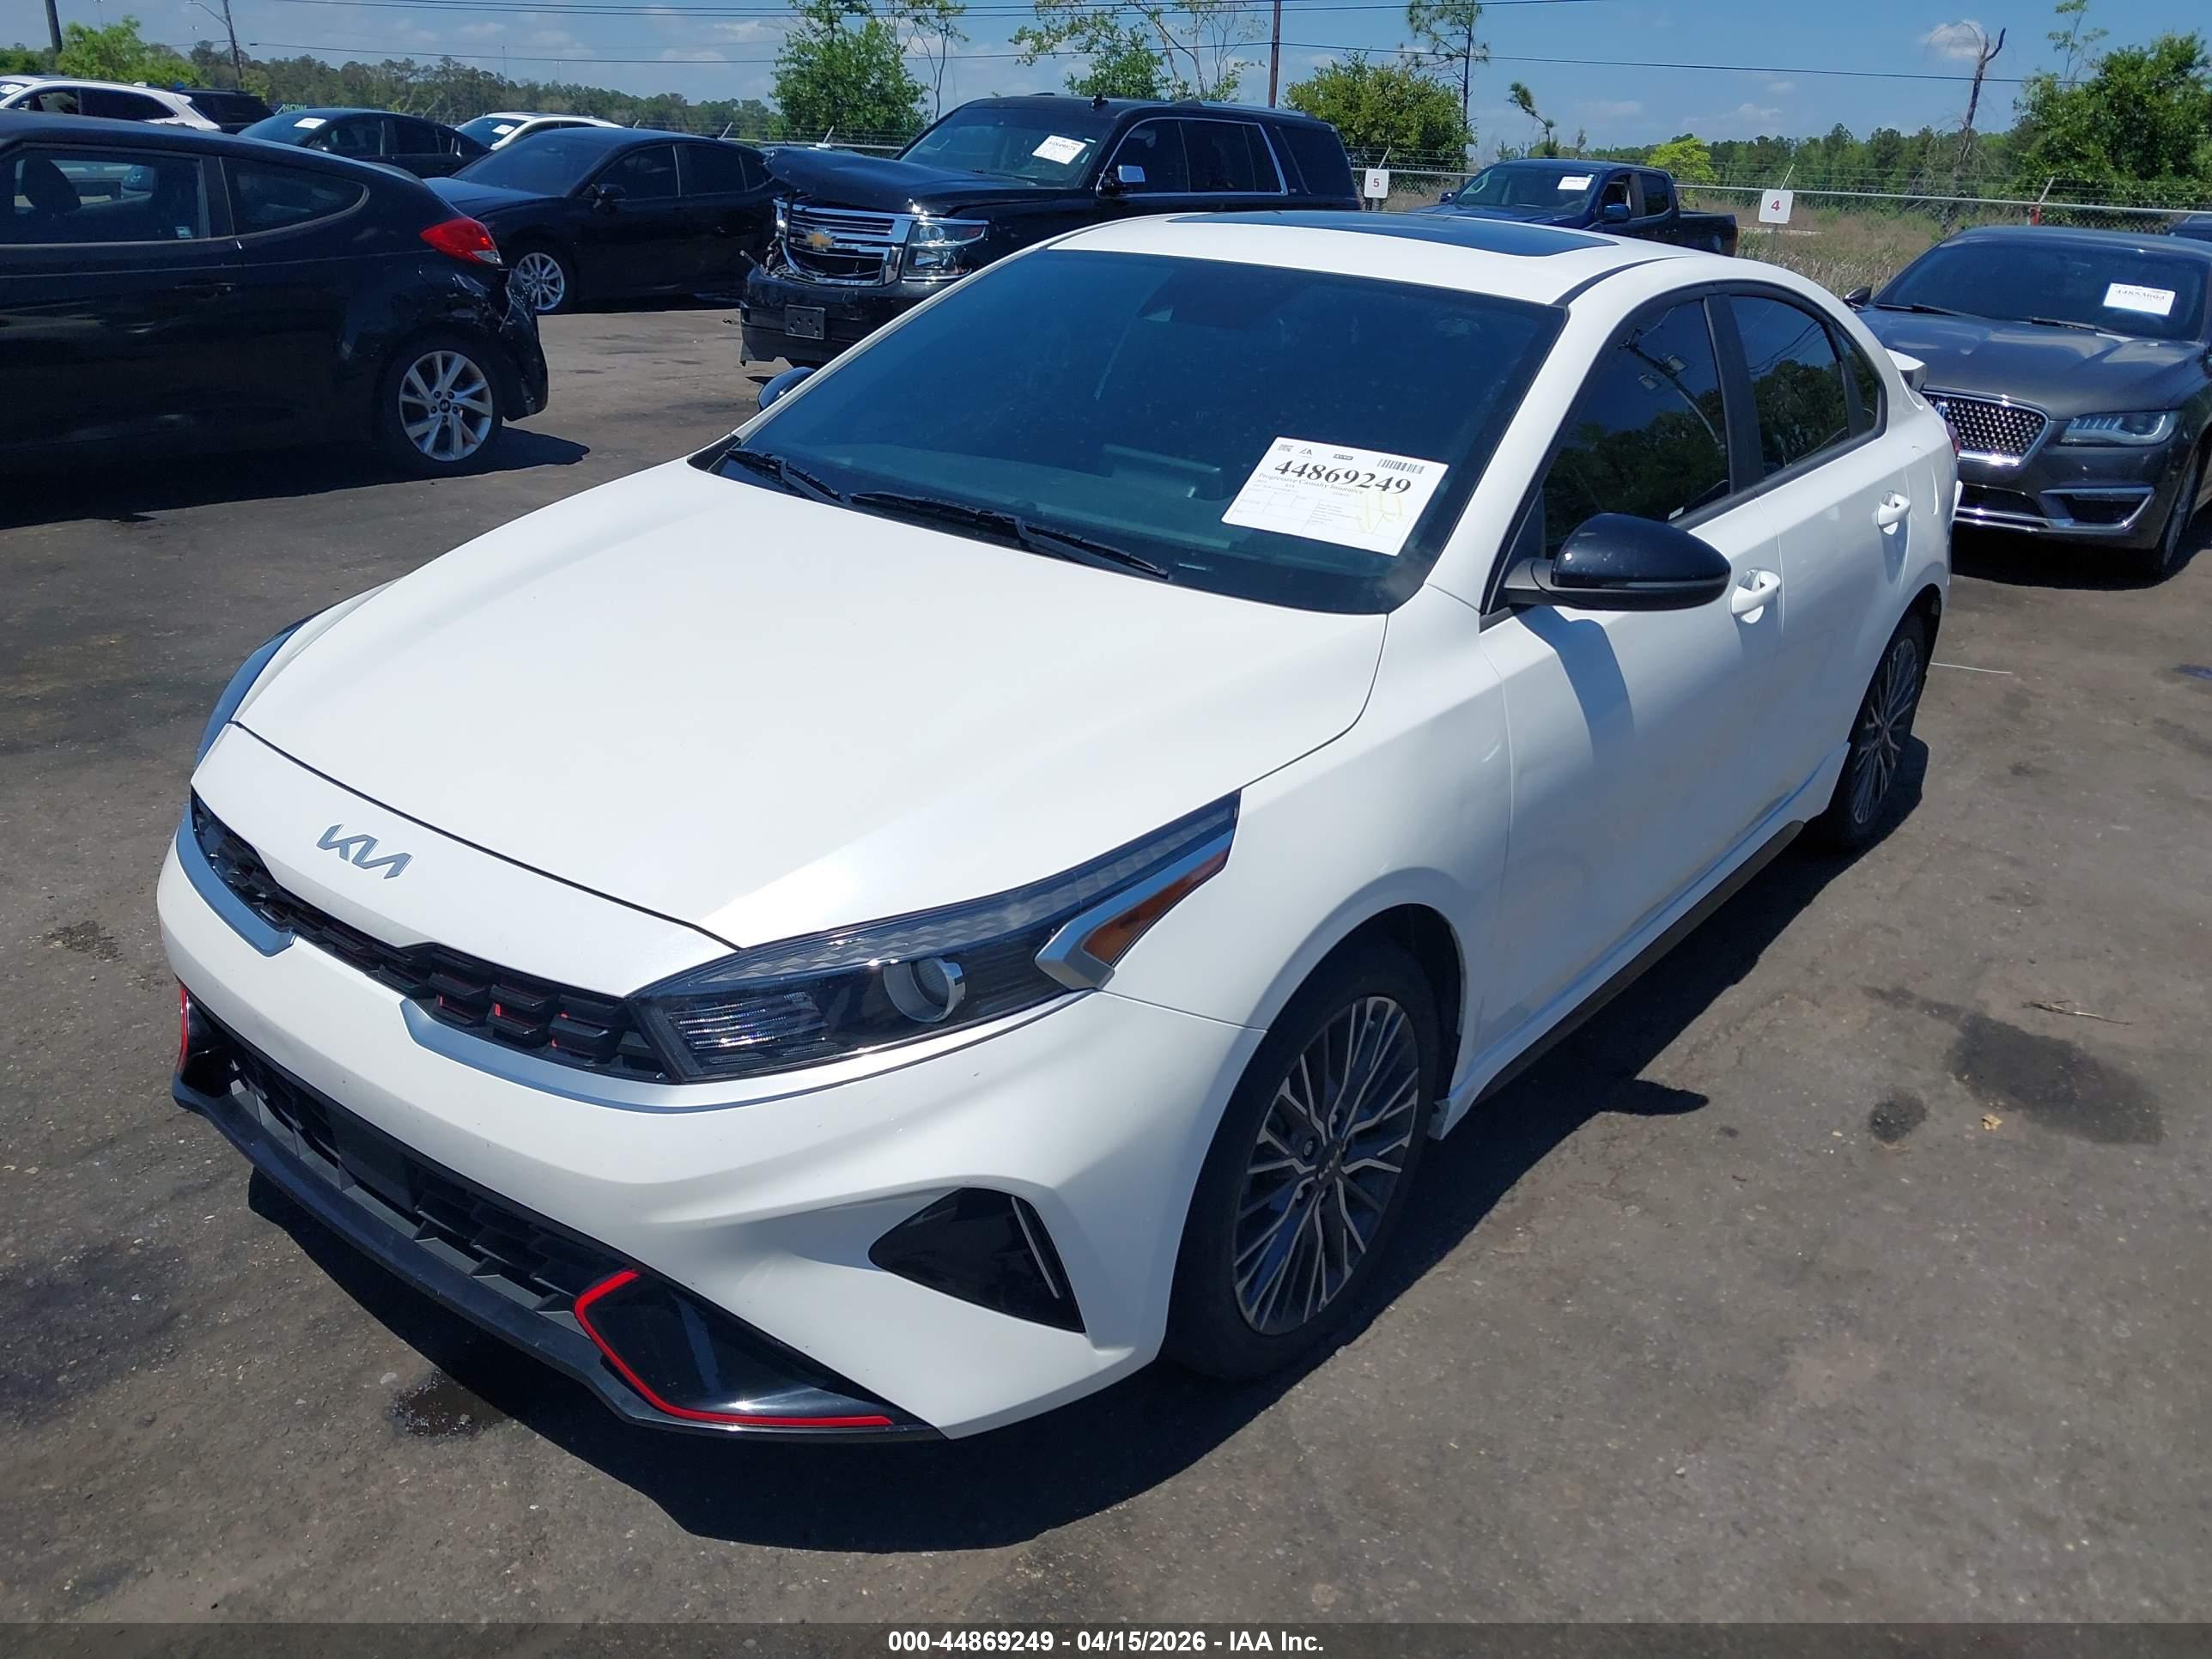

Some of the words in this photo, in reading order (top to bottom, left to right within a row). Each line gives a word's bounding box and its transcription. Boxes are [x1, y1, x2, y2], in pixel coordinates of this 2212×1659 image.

[1374, 178, 1380, 188] 5
[1771, 199, 1781, 211] 4
[1274, 459, 1412, 495] 44869249
